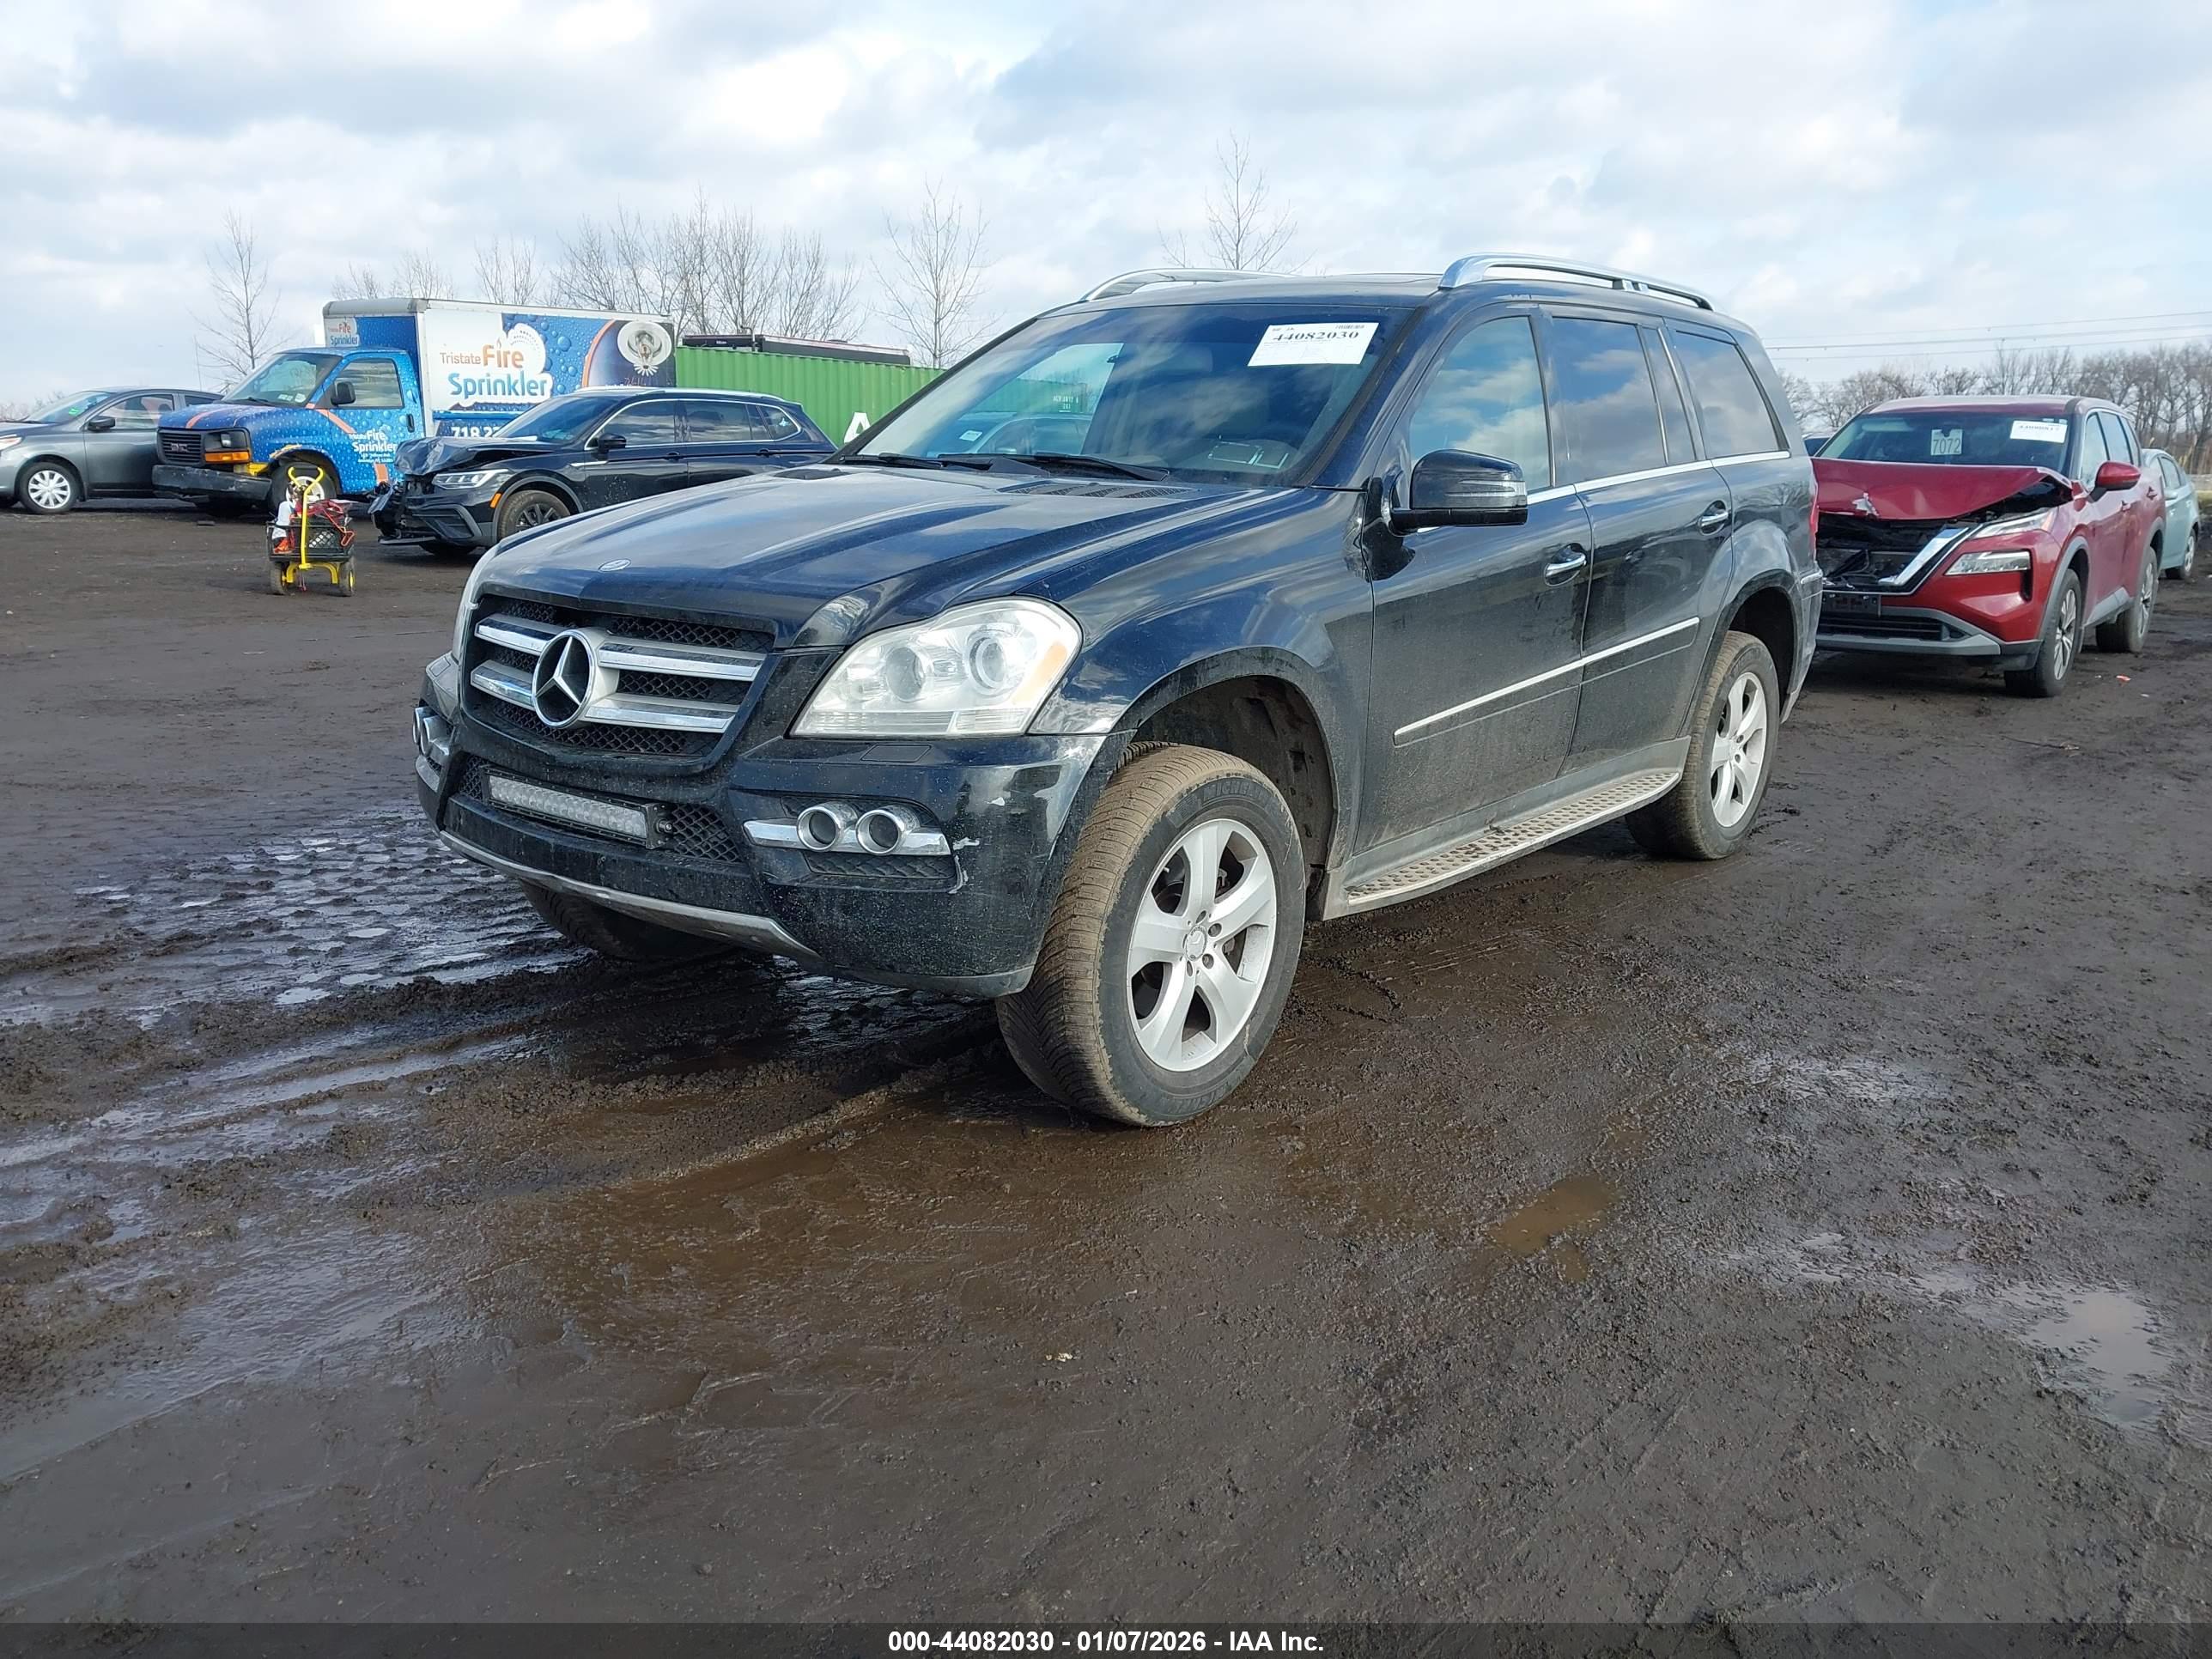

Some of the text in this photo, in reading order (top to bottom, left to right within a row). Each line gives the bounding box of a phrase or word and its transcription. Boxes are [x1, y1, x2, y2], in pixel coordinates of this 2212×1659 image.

[1273, 331, 1359, 342] 44082030
[440, 339, 525, 368] Tristate Fire
[447, 371, 548, 399] Sprinkler
[367, 428, 386, 440] Fire
[1933, 439, 1960, 454] 7072
